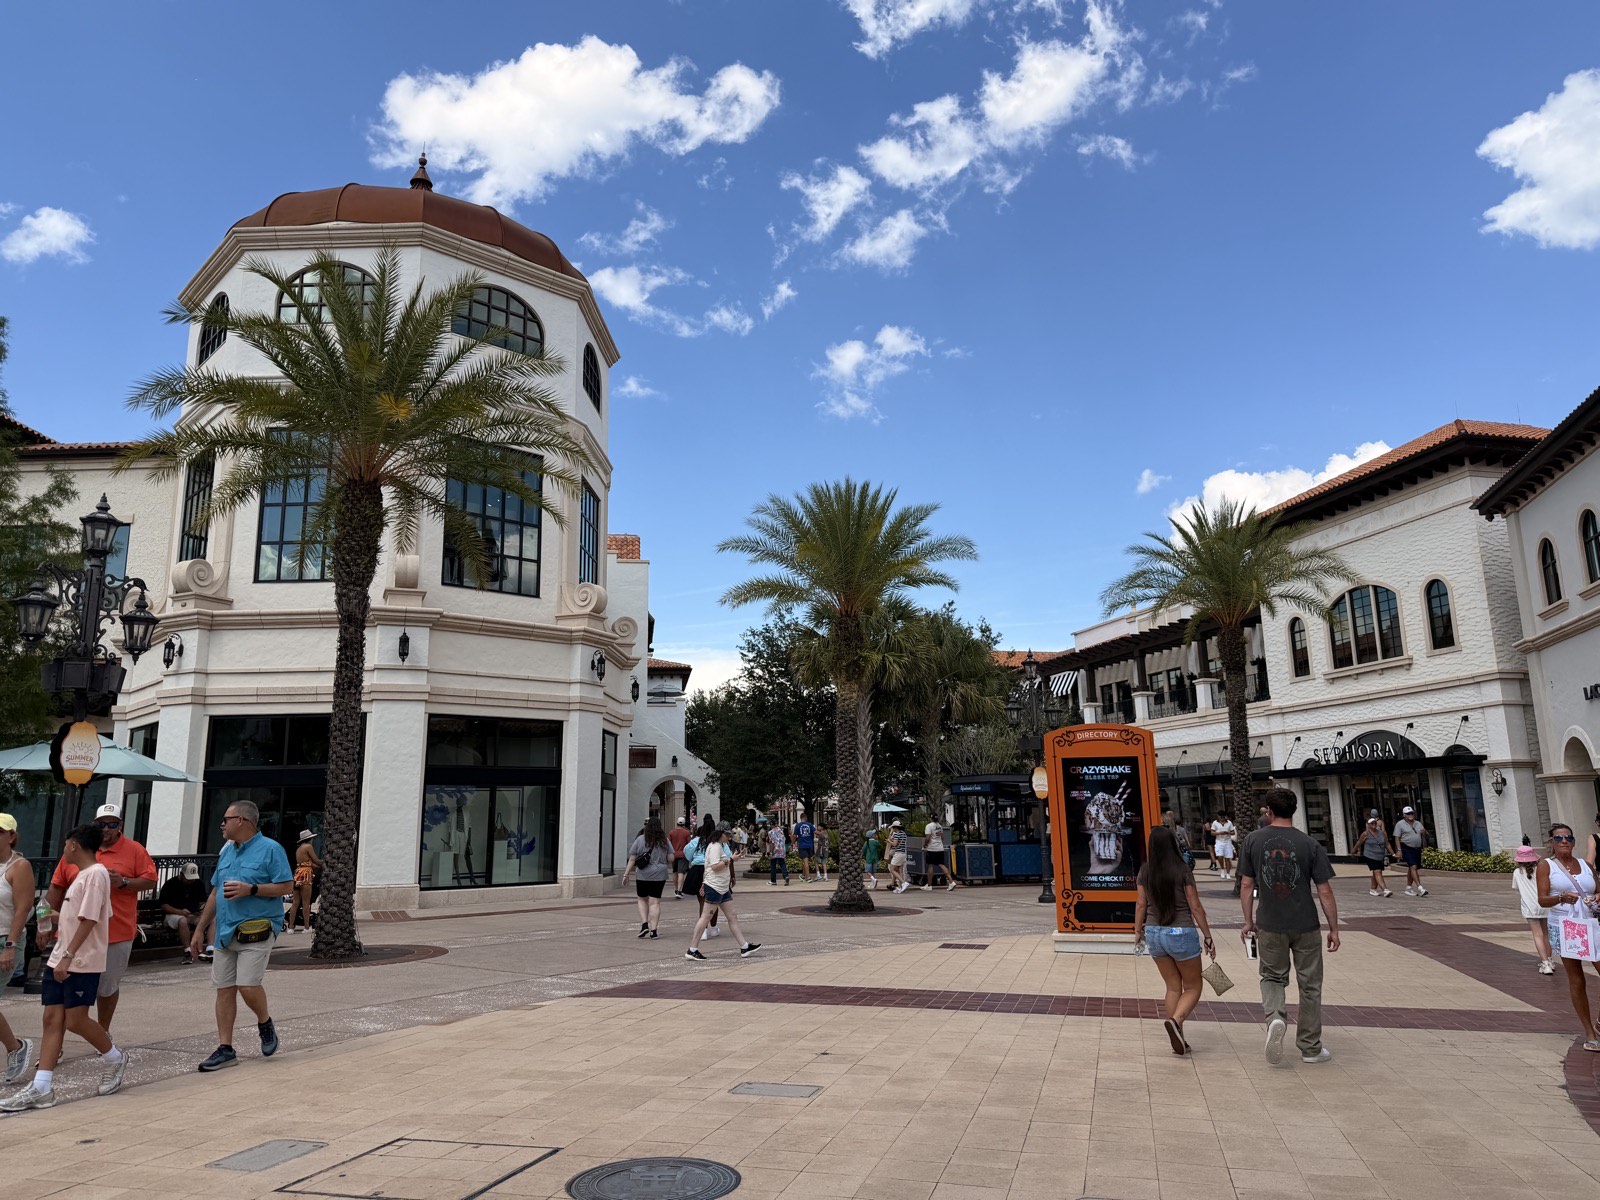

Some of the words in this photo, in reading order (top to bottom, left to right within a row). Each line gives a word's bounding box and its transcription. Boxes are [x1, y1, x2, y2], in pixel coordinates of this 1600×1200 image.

[1076, 731, 1118, 740] DIRECTORY
[1313, 740, 1396, 763] SEPHORA
[65, 754, 94, 764] SUMMER
[1070, 765, 1131, 774] CRAZYSHAKE
